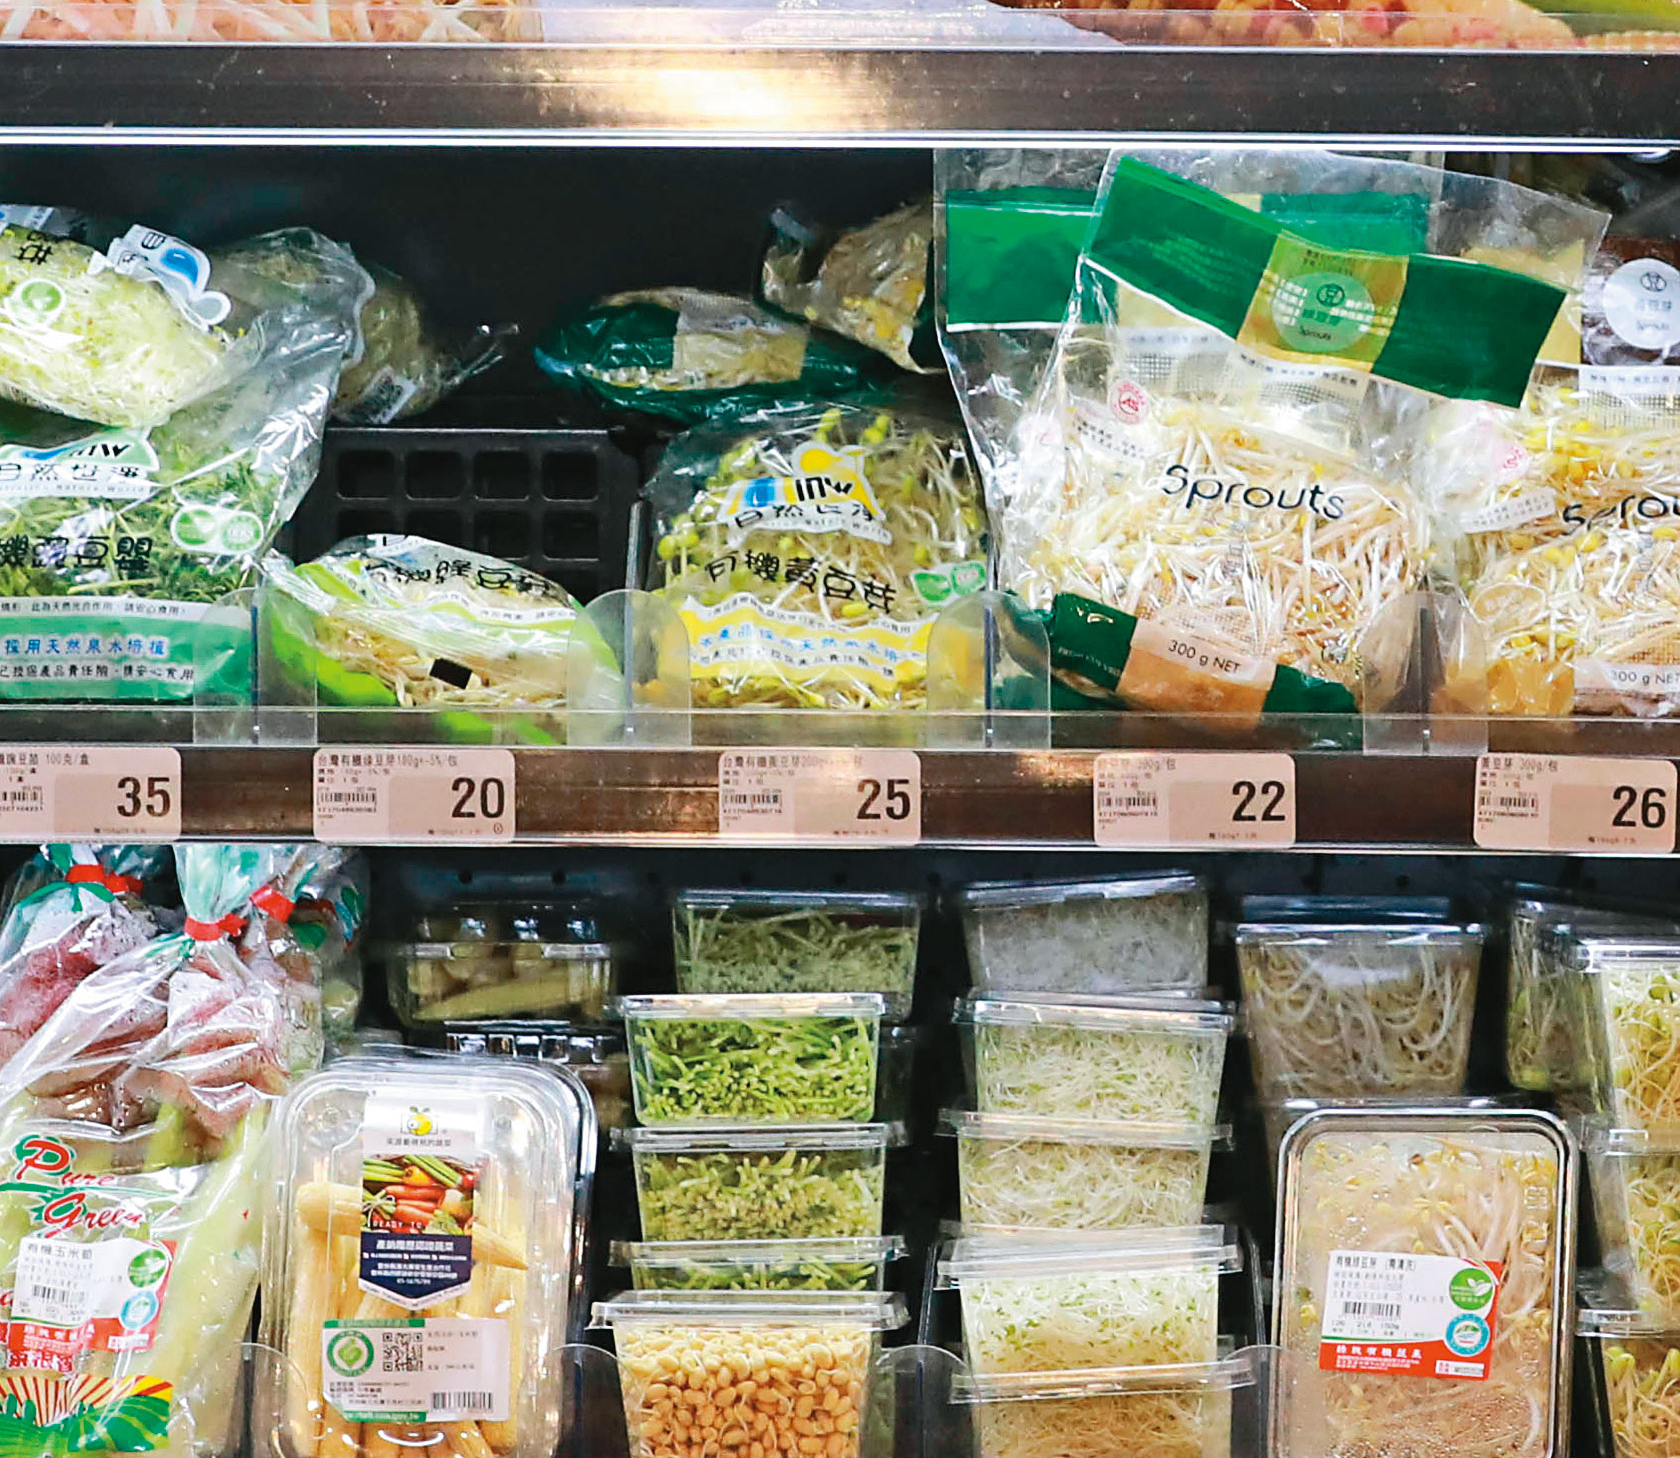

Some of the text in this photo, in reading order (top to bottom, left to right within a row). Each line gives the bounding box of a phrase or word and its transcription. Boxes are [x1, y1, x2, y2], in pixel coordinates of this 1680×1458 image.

[1161, 464, 1346, 520] Sprouts
[1168, 639, 1241, 674] 300 g NET
[1641, 674, 1651, 687] g
[1655, 670, 1680, 683] NET
[118, 777, 170, 816] 35
[452, 778, 504, 818] 20
[857, 780, 910, 819] 25
[1233, 781, 1285, 821] 22
[1613, 786, 1665, 828] 26
[16, 1138, 116, 1187] Pure
[44, 1192, 142, 1239] Green
